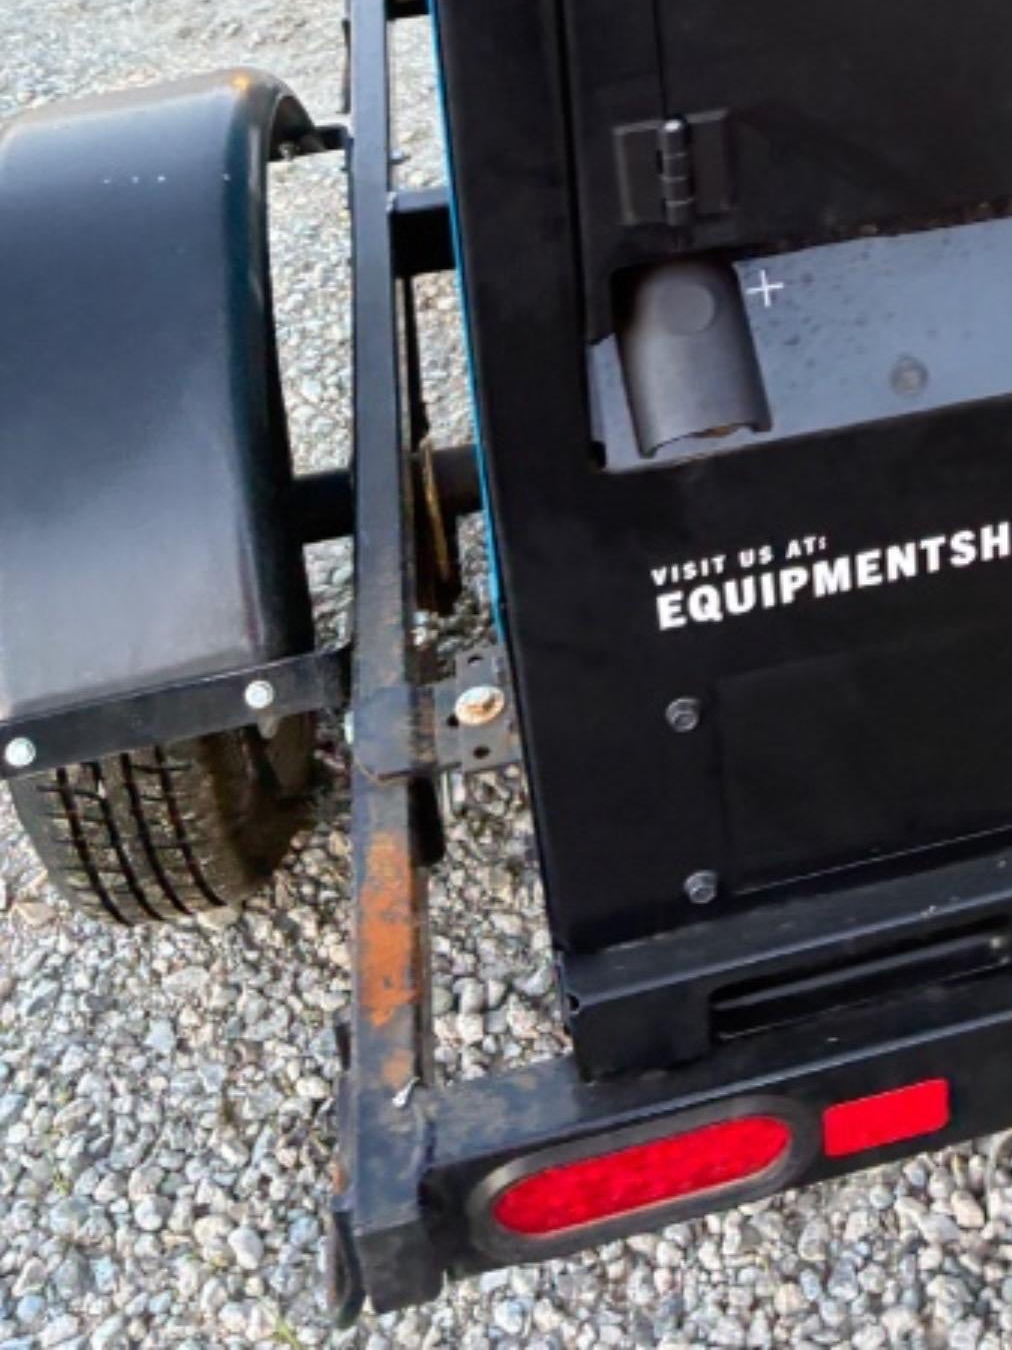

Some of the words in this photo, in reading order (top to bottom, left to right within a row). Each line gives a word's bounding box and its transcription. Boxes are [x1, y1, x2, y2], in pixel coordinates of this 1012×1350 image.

[651, 554, 726, 586] VISIT
[739, 545, 773, 568] US
[785, 536, 826, 559] AT:
